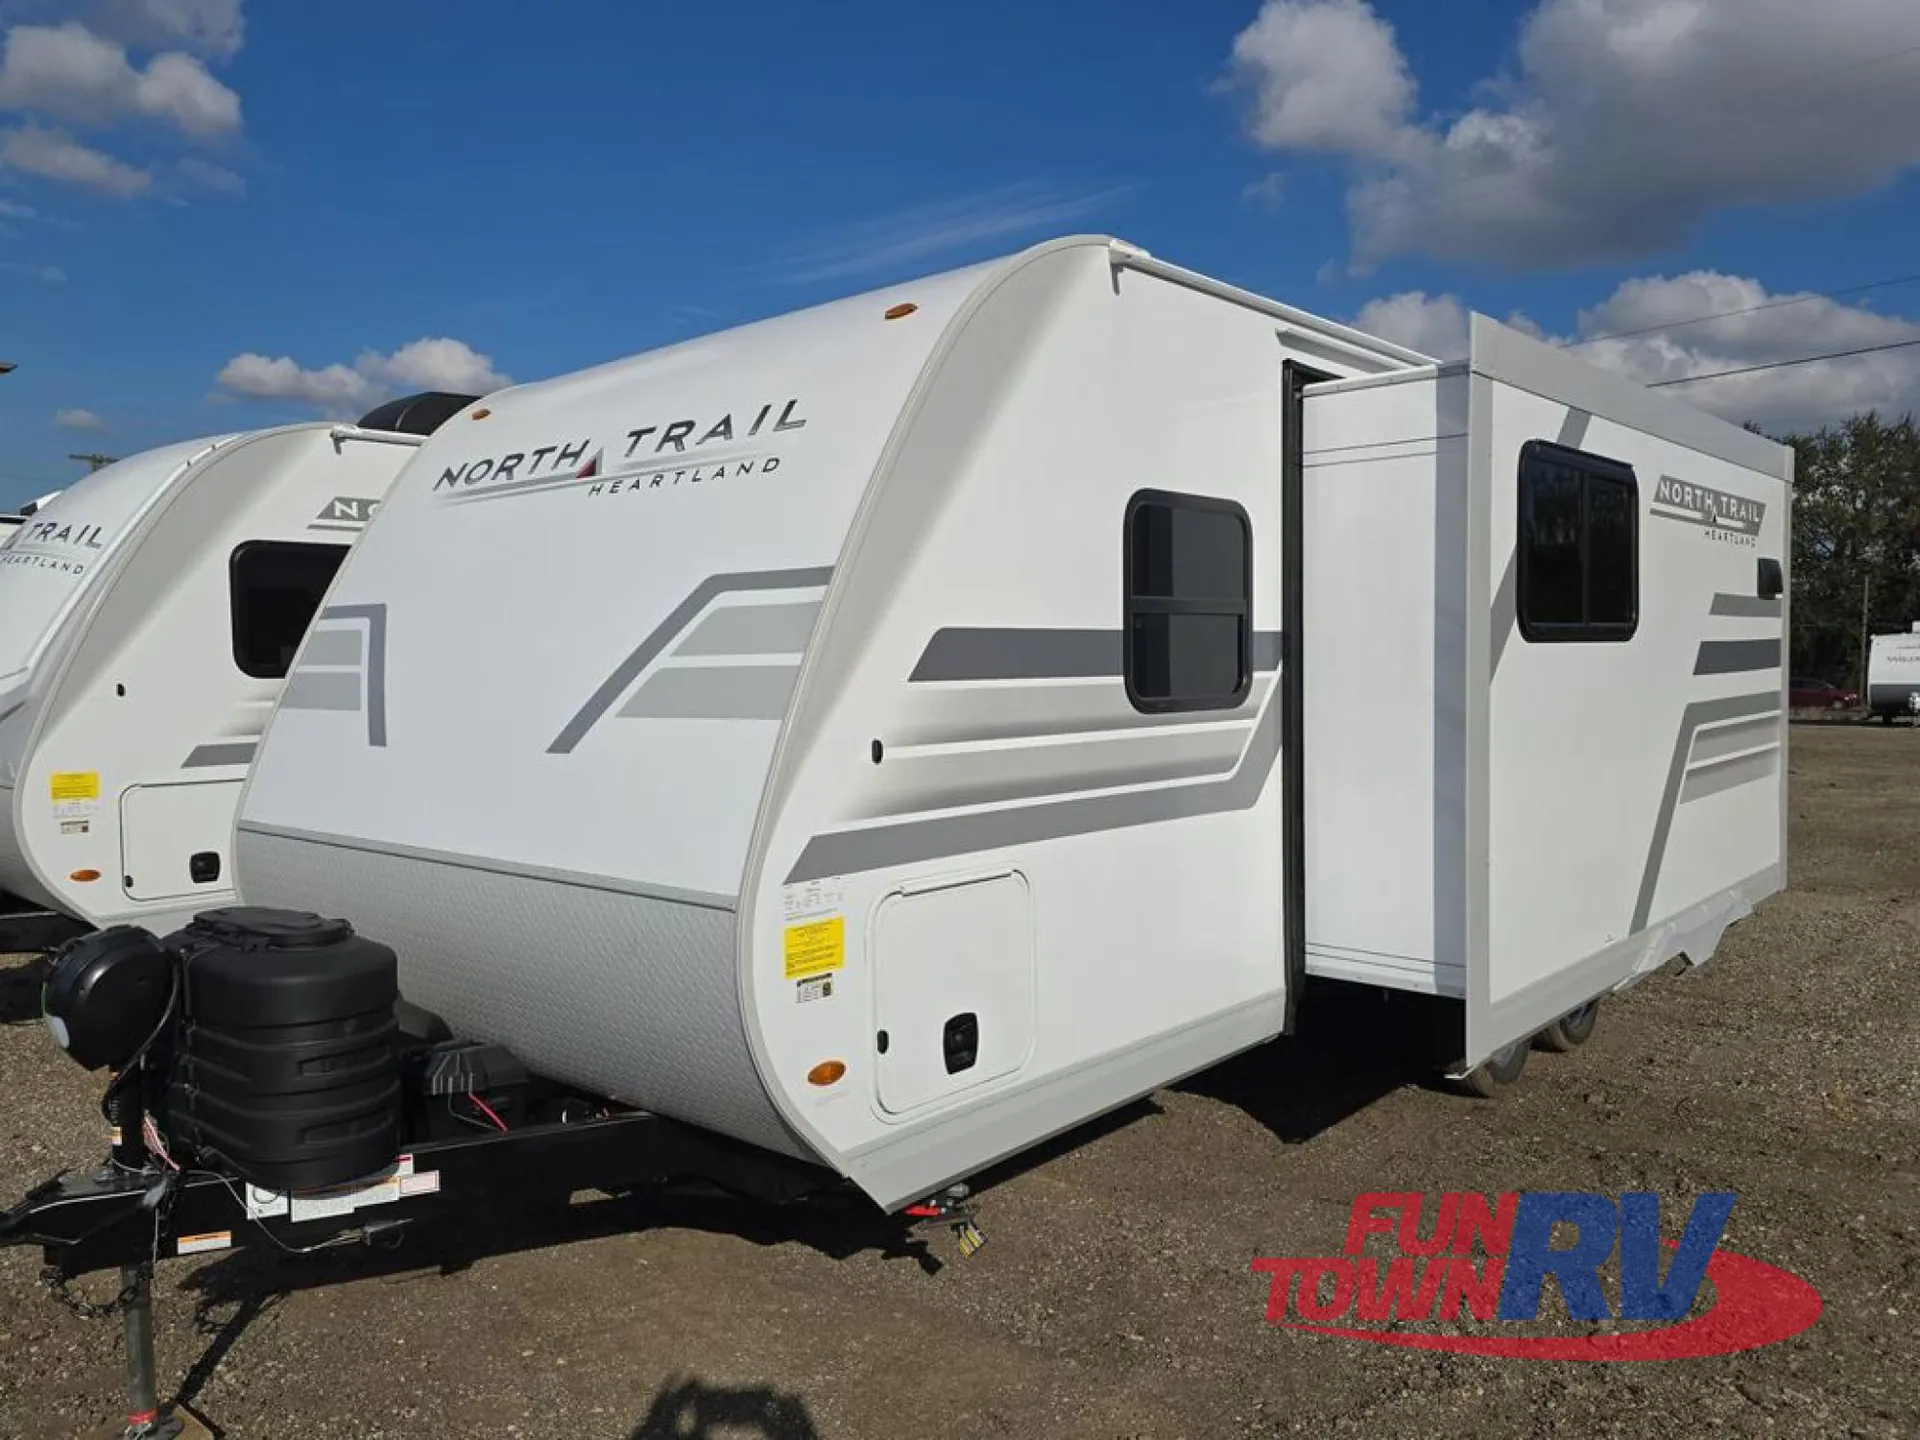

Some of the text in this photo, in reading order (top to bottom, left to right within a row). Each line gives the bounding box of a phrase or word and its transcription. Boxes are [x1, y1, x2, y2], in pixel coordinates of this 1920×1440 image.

[432, 399, 807, 492] NORTH TRAIL
[588, 456, 781, 498] HEARTLAND
[1660, 480, 1760, 522] NORTH TRAIL
[23, 522, 103, 549] TRAIL
